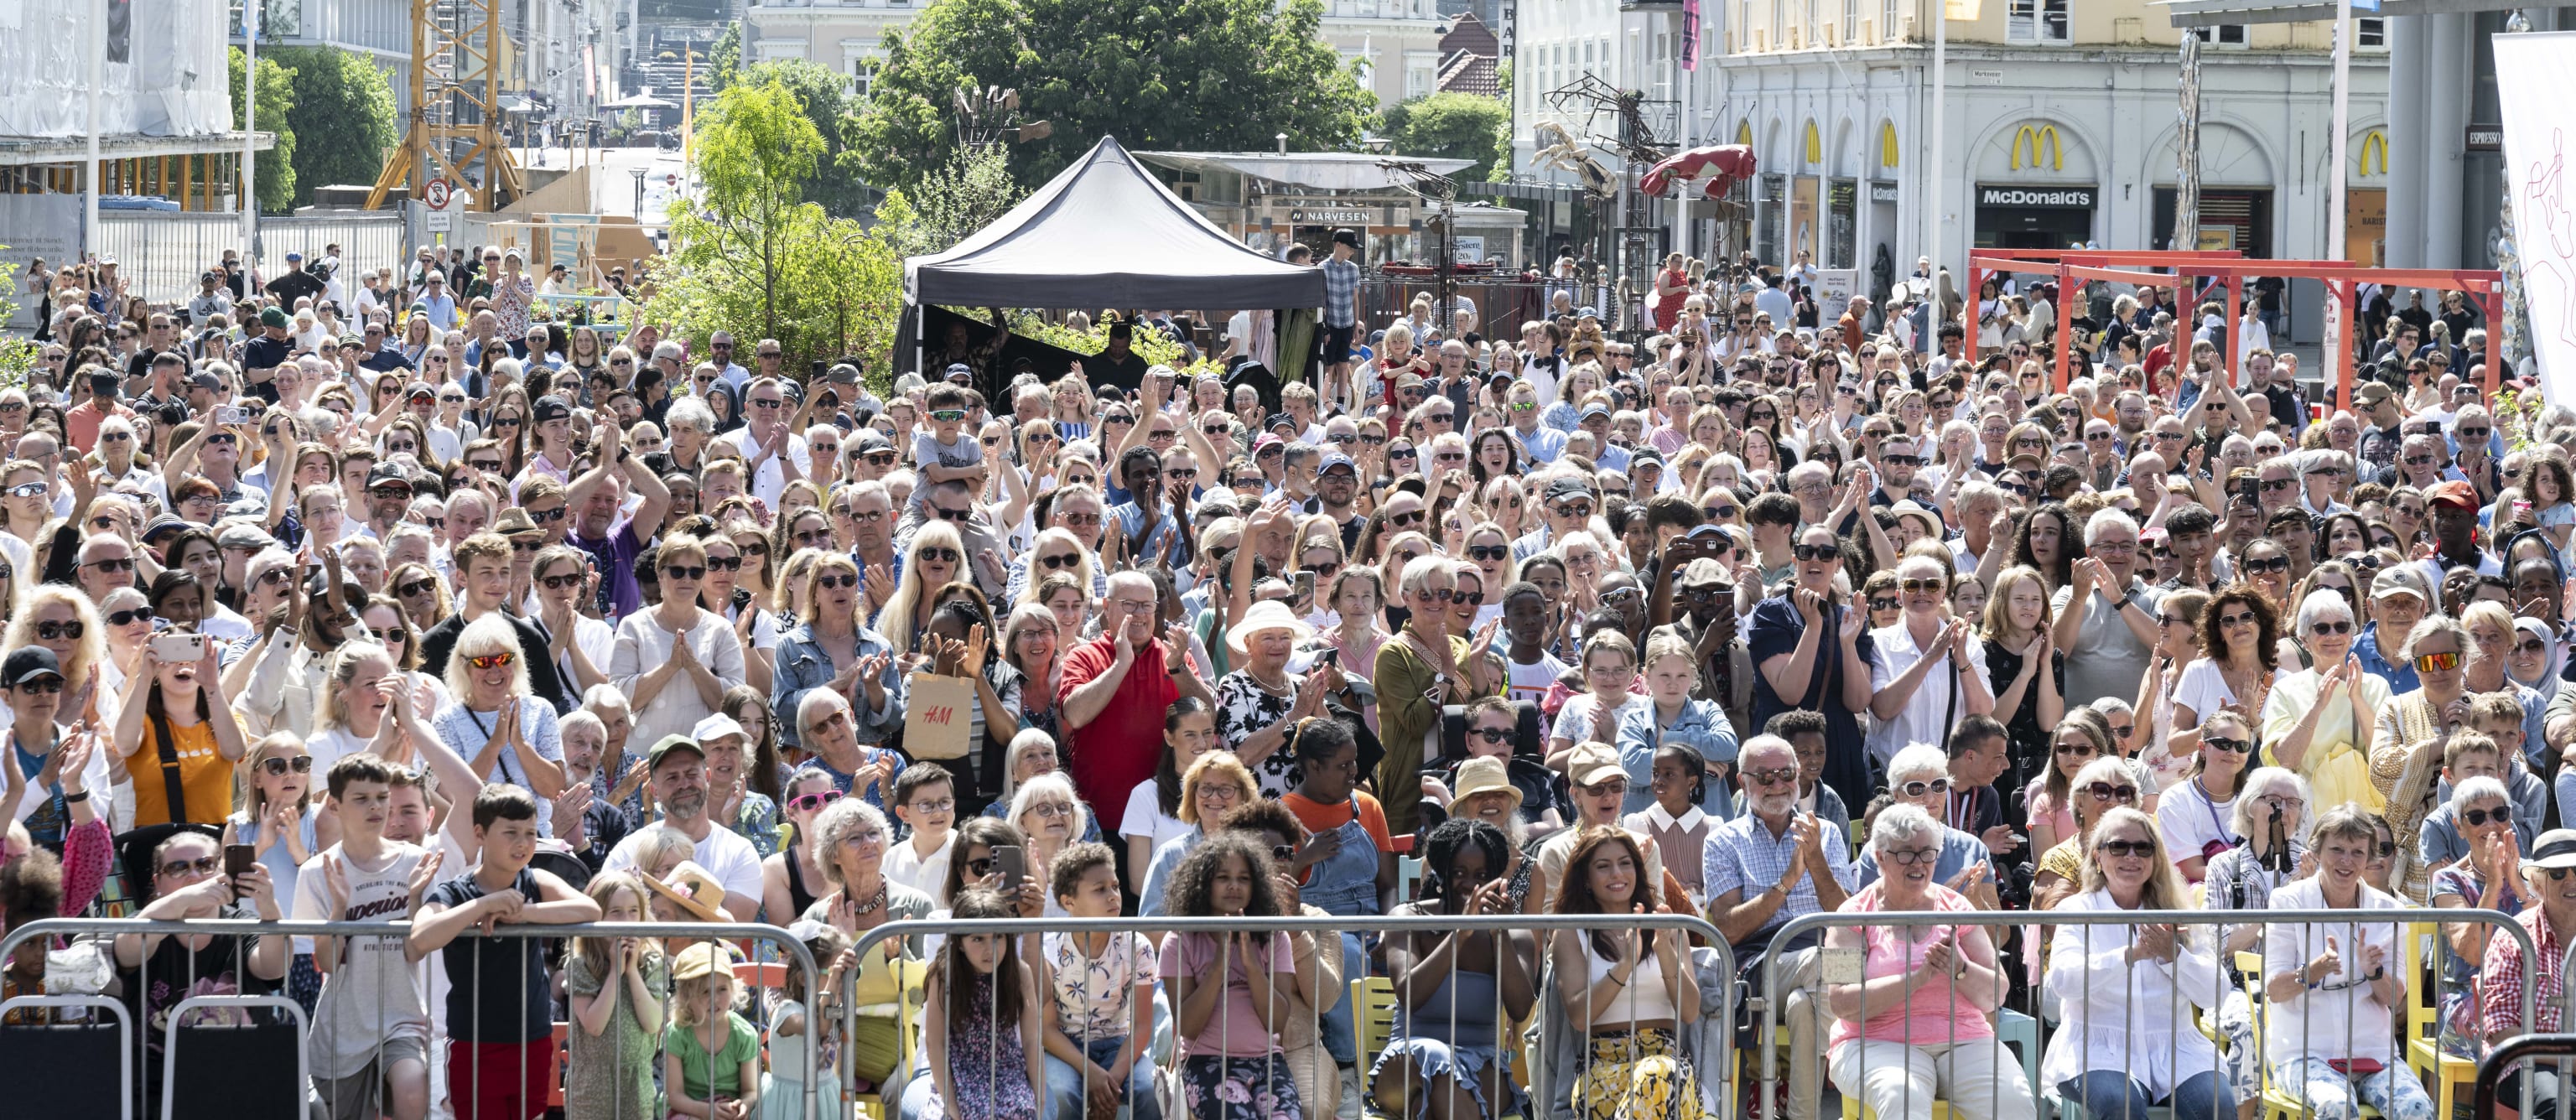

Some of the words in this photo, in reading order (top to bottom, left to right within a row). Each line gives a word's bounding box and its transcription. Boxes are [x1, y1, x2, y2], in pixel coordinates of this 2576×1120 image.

[1503, 8, 1514, 56] BAR
[2470, 132, 2501, 145] ESPRESSO
[1983, 190, 2090, 205] McDonald's
[1307, 212, 1369, 221] NARVESEN
[345, 891, 409, 920] uperior
